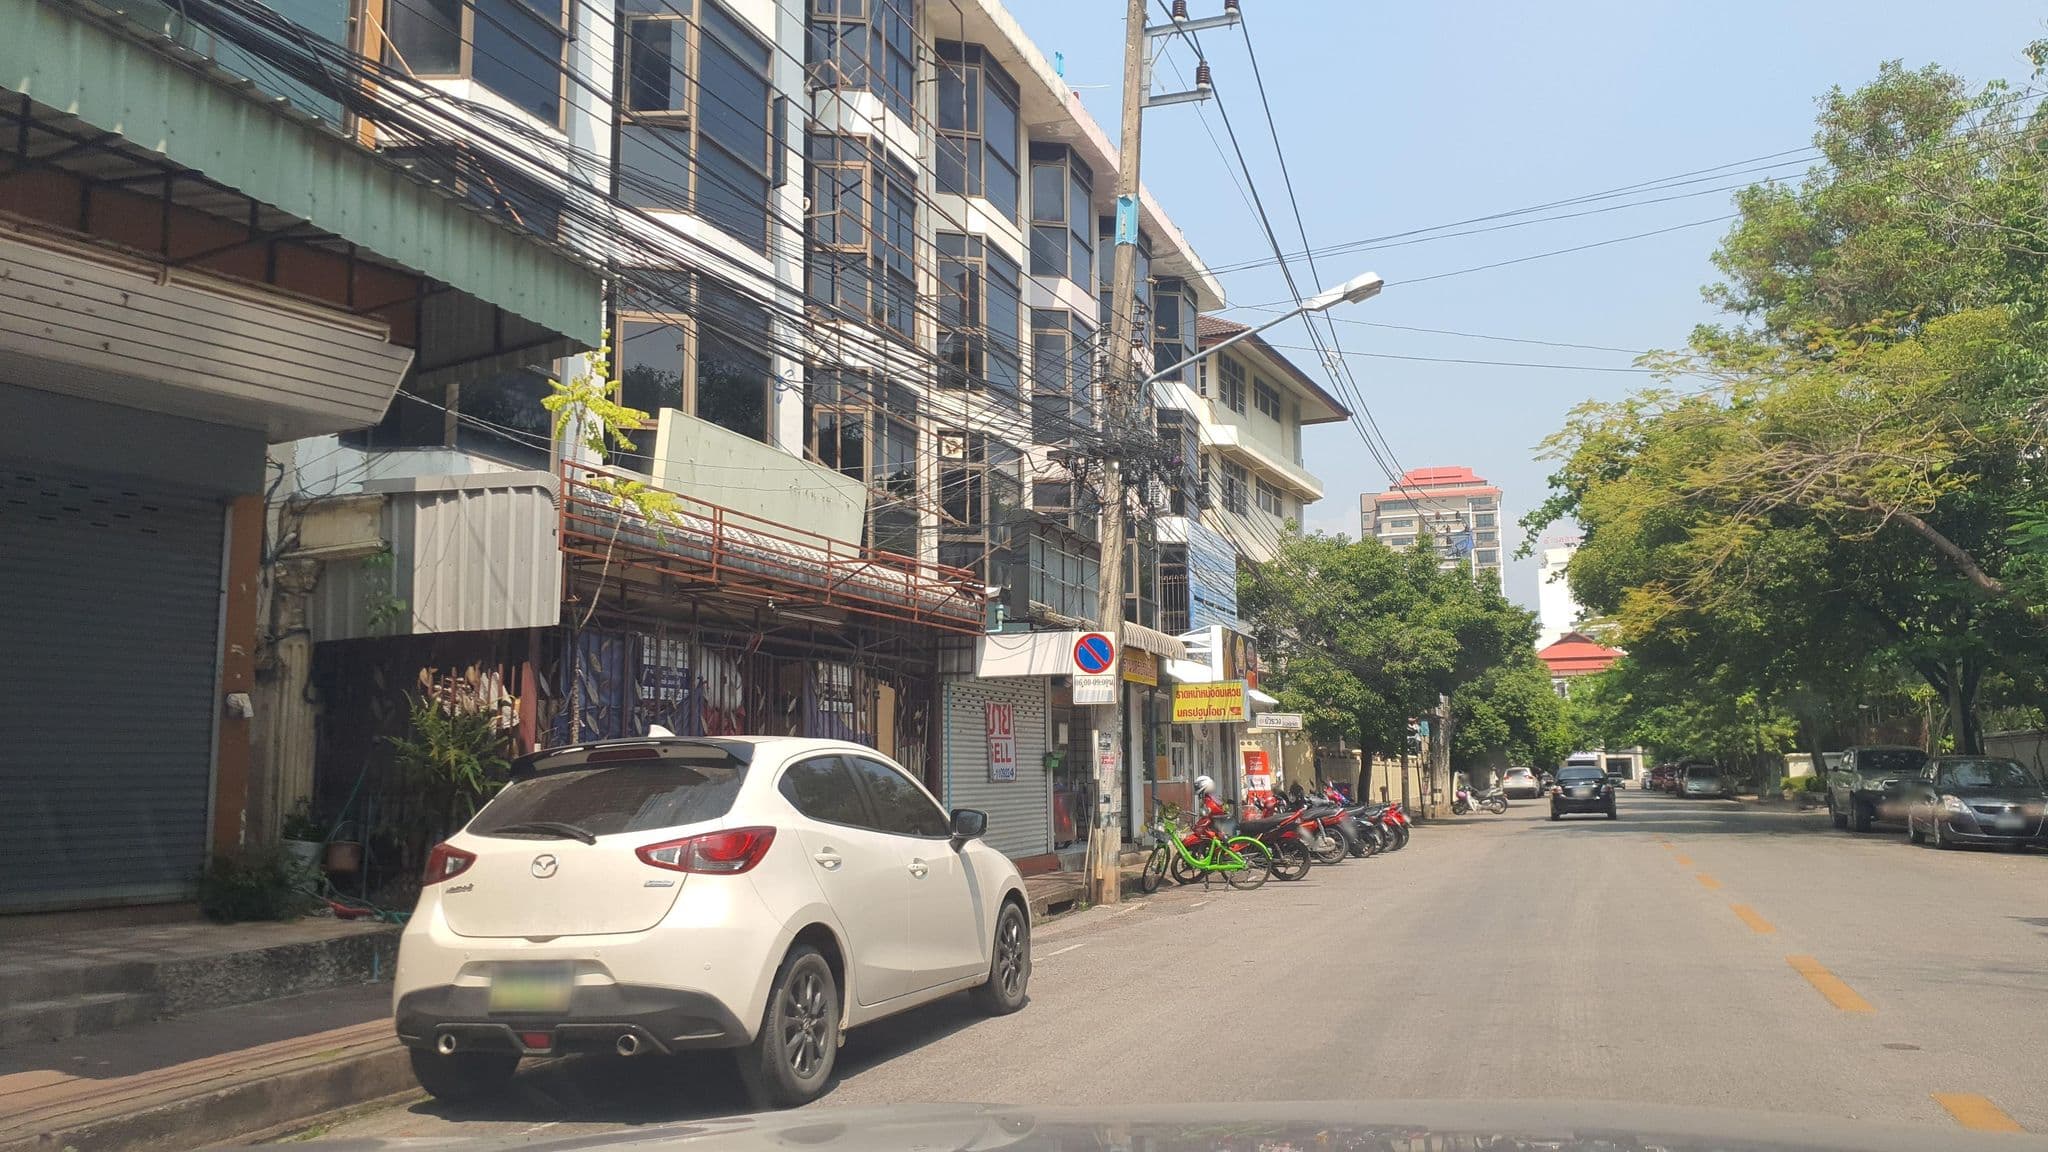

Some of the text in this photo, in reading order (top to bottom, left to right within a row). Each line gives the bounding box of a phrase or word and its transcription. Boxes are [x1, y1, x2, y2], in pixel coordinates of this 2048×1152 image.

[986, 702, 1011, 735] ขาย
[1177, 704, 1226, 720] นครปฐมโอชา
